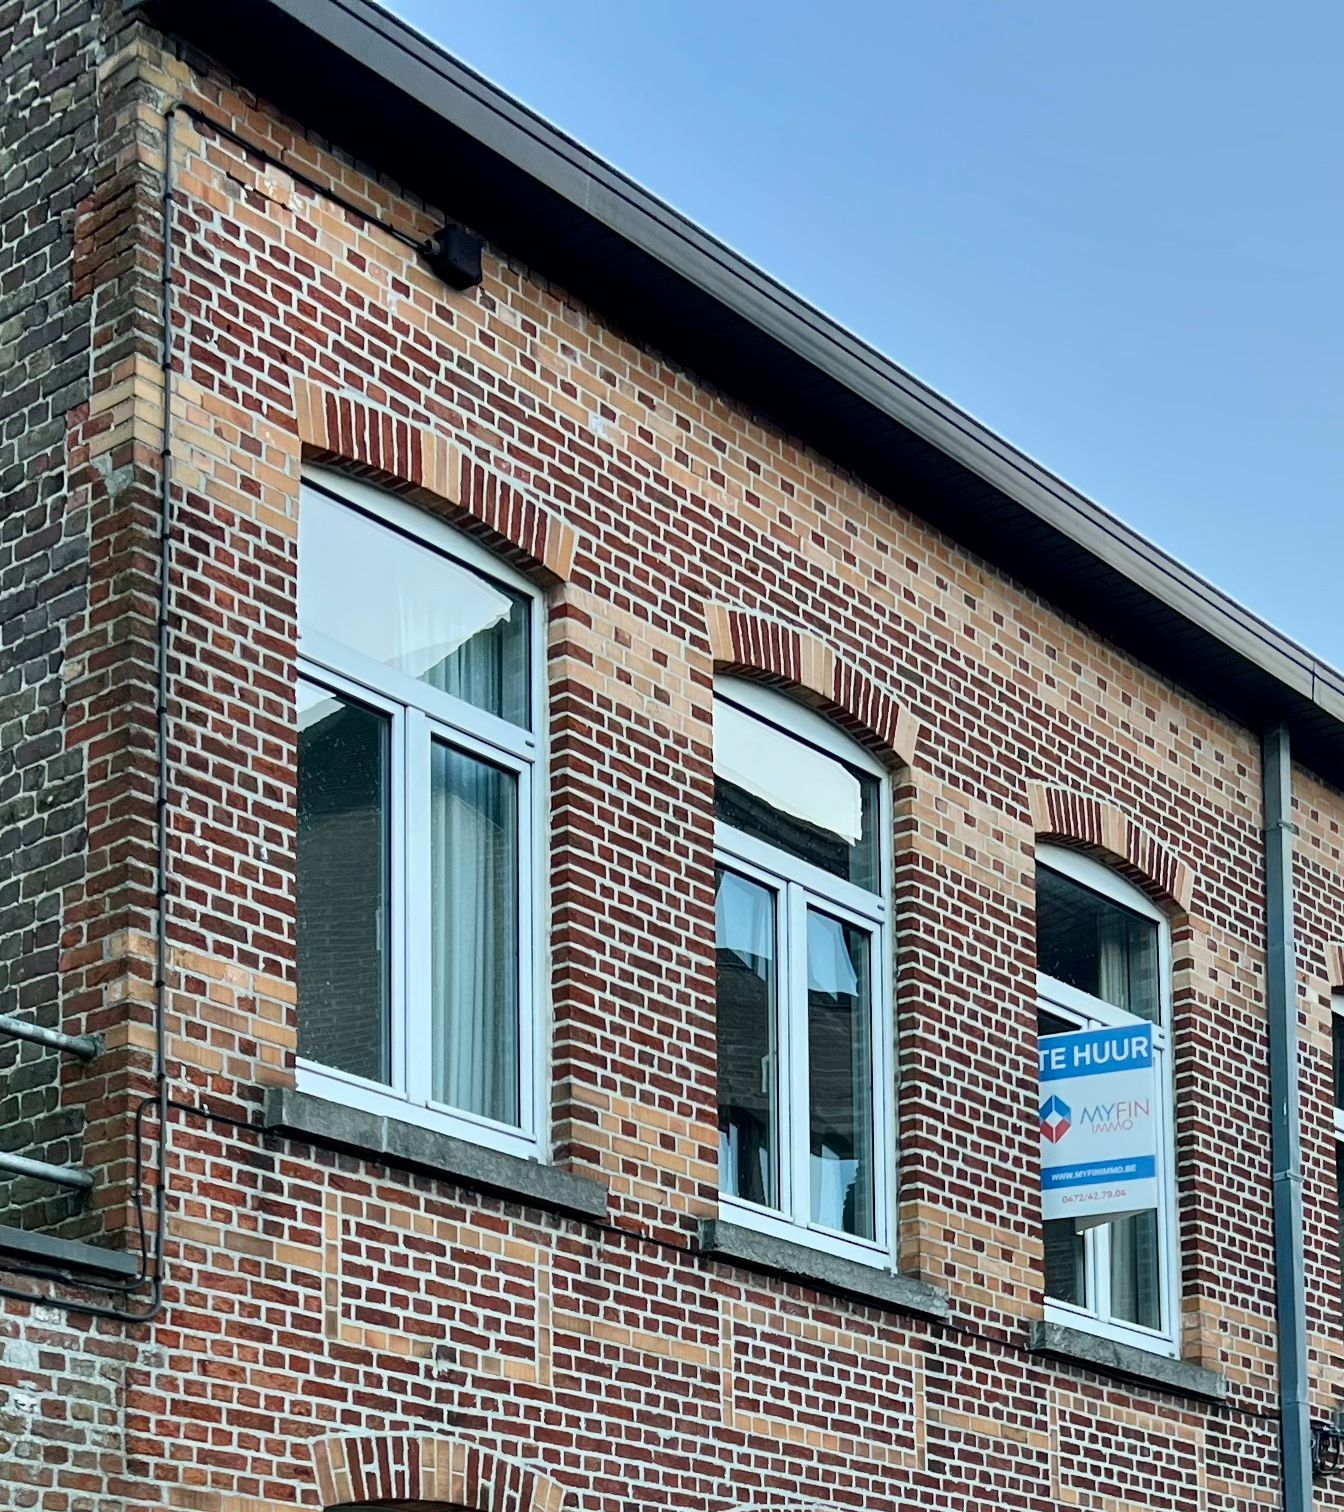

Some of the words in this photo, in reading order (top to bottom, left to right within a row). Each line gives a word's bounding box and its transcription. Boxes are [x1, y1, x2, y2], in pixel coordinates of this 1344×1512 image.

[1038, 1047, 1066, 1072] TE
[1073, 1036, 1148, 1067] HUUR
[1079, 1098, 1150, 1126] MYFIN
[1091, 1118, 1134, 1134] IMMO
